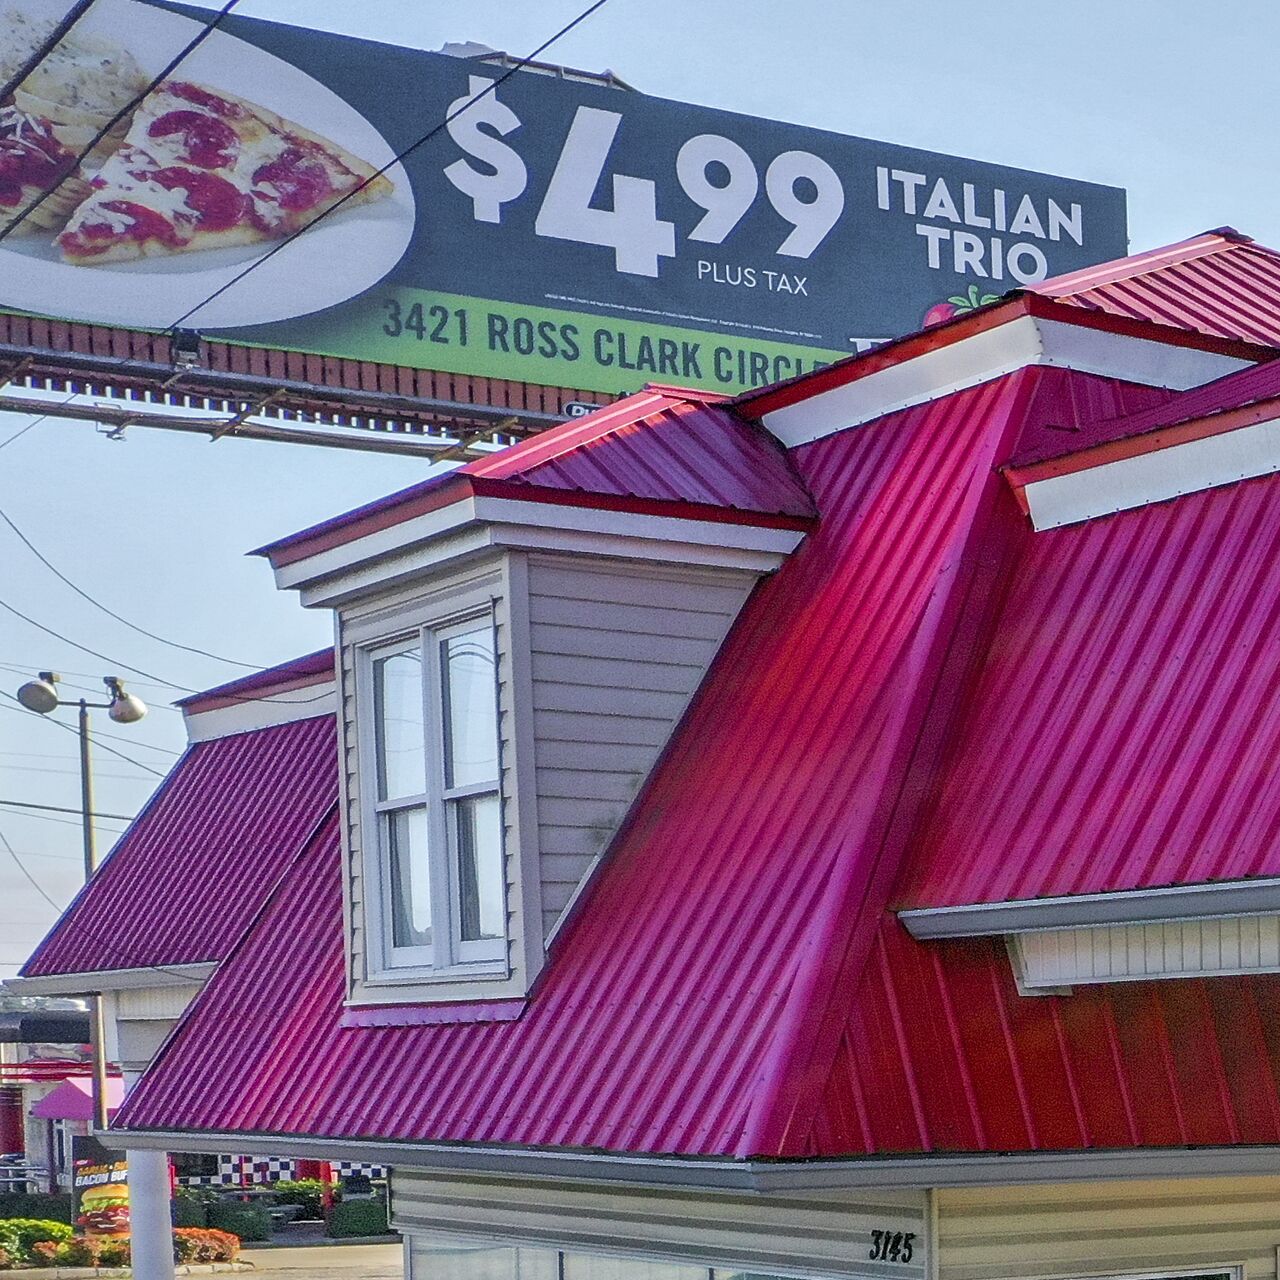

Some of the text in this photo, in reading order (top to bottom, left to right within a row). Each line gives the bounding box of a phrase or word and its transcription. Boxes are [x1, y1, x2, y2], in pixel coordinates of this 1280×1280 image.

[876, 166, 1083, 246] ITALIAN
[916, 223, 1048, 283] TRIO
[697, 260, 808, 297] PLUS TAX
[382, 304, 470, 347] 3421
[487, 318, 581, 361] ROSS
[593, 330, 702, 379] CLARK
[75, 1172, 109, 1187] BACON
[869, 1229, 916, 1263] 3145
